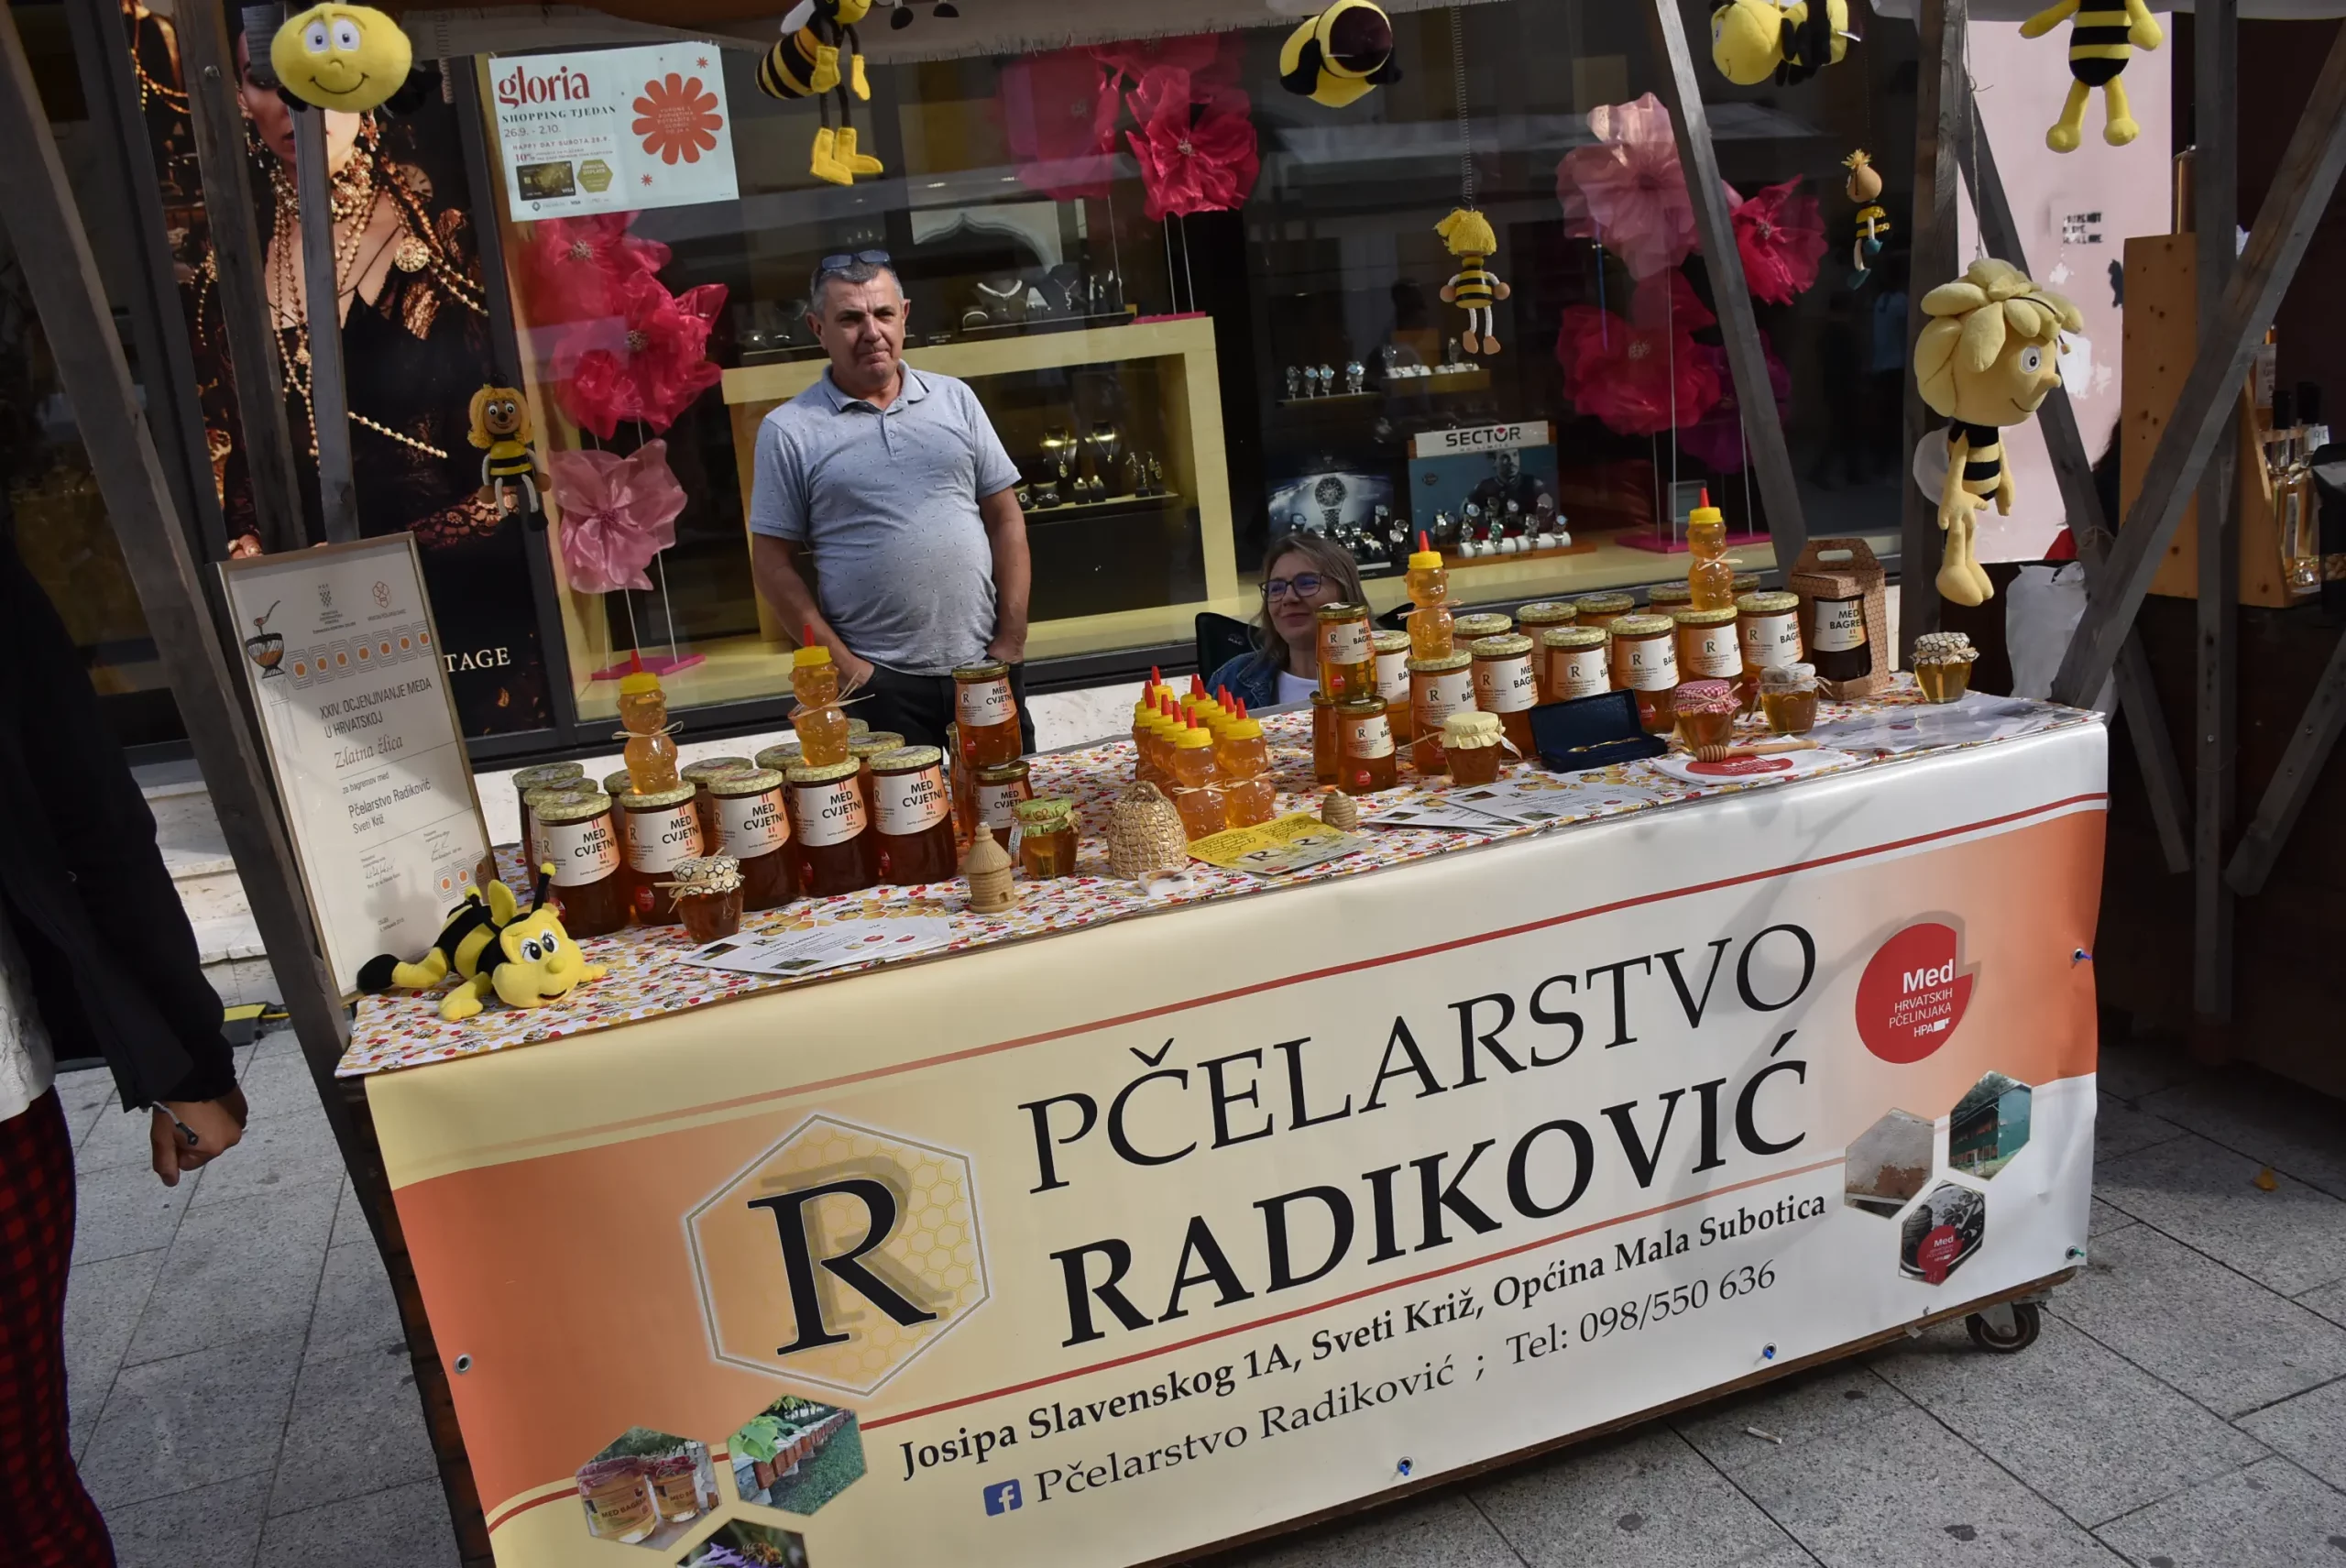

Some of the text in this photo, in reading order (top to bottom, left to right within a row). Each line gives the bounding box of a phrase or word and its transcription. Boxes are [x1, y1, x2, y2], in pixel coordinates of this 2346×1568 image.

[499, 66, 590, 109] gloria
[502, 105, 617, 124] SHOPPING TJEDAN
[504, 127, 529, 138] 26.9.
[539, 124, 561, 135] 2.10.
[558, 138, 589, 147] SUBOTA
[1445, 426, 1521, 447] SECTOR
[1838, 609, 1859, 619] MED
[1331, 634, 1337, 642] R
[1749, 630, 1758, 640] R
[1706, 641, 1716, 652] R
[1632, 653, 1641, 665] R
[1570, 665, 1580, 677] R
[1483, 674, 1491, 685] R
[992, 685, 1007, 695] MED
[1430, 690, 1439, 701] R
[319, 677, 433, 720] XXIV. OCJENJIVANJE MEDA
[963, 693, 969, 703] R
[324, 710, 383, 739] U HRVATSKOJ
[1358, 729, 1365, 738] R
[334, 733, 403, 769] Zlatna žlica
[378, 772, 389, 784] med
[911, 780, 933, 794] MED
[348, 778, 432, 817] Pčelarstvo Radiković
[830, 791, 853, 805] MED
[874, 789, 881, 803] R
[903, 789, 943, 807] CVJETNI
[1001, 791, 1019, 799] MED
[752, 803, 775, 817] MED
[822, 799, 862, 818] CVJETNI
[353, 813, 385, 835] Sveti Križ
[670, 816, 692, 829] MED
[716, 812, 720, 825] R
[743, 812, 784, 830] CVJETNI
[583, 828, 606, 843] MED
[630, 828, 637, 840] R
[543, 840, 550, 852] R
[575, 837, 615, 858] CVJETNI
[1903, 959, 1954, 993] Med
[1894, 988, 1953, 1013] HRVATSKIH
[1889, 1003, 1952, 1028] PČELINJAKA
[1913, 1023, 1934, 1037] HPA
[1018, 924, 1816, 1194] PČELARSTVO
[1050, 1031, 1807, 1347] RADIKOVIĆ
[1934, 1235, 1954, 1247] Med
[748, 1179, 940, 1356] R
[899, 1194, 1826, 1481] Josipa Slavenskog 1A, Sveti Križ, Općina Mala Subotica
[1035, 1424, 1248, 1503] Pčelarstvo
[1259, 1355, 1454, 1440] Radiković
[1506, 1325, 1568, 1365] Tel:
[1579, 1278, 1708, 1343] 098/550
[1718, 1259, 1777, 1301] 636
[601, 1508, 619, 1518] MED
